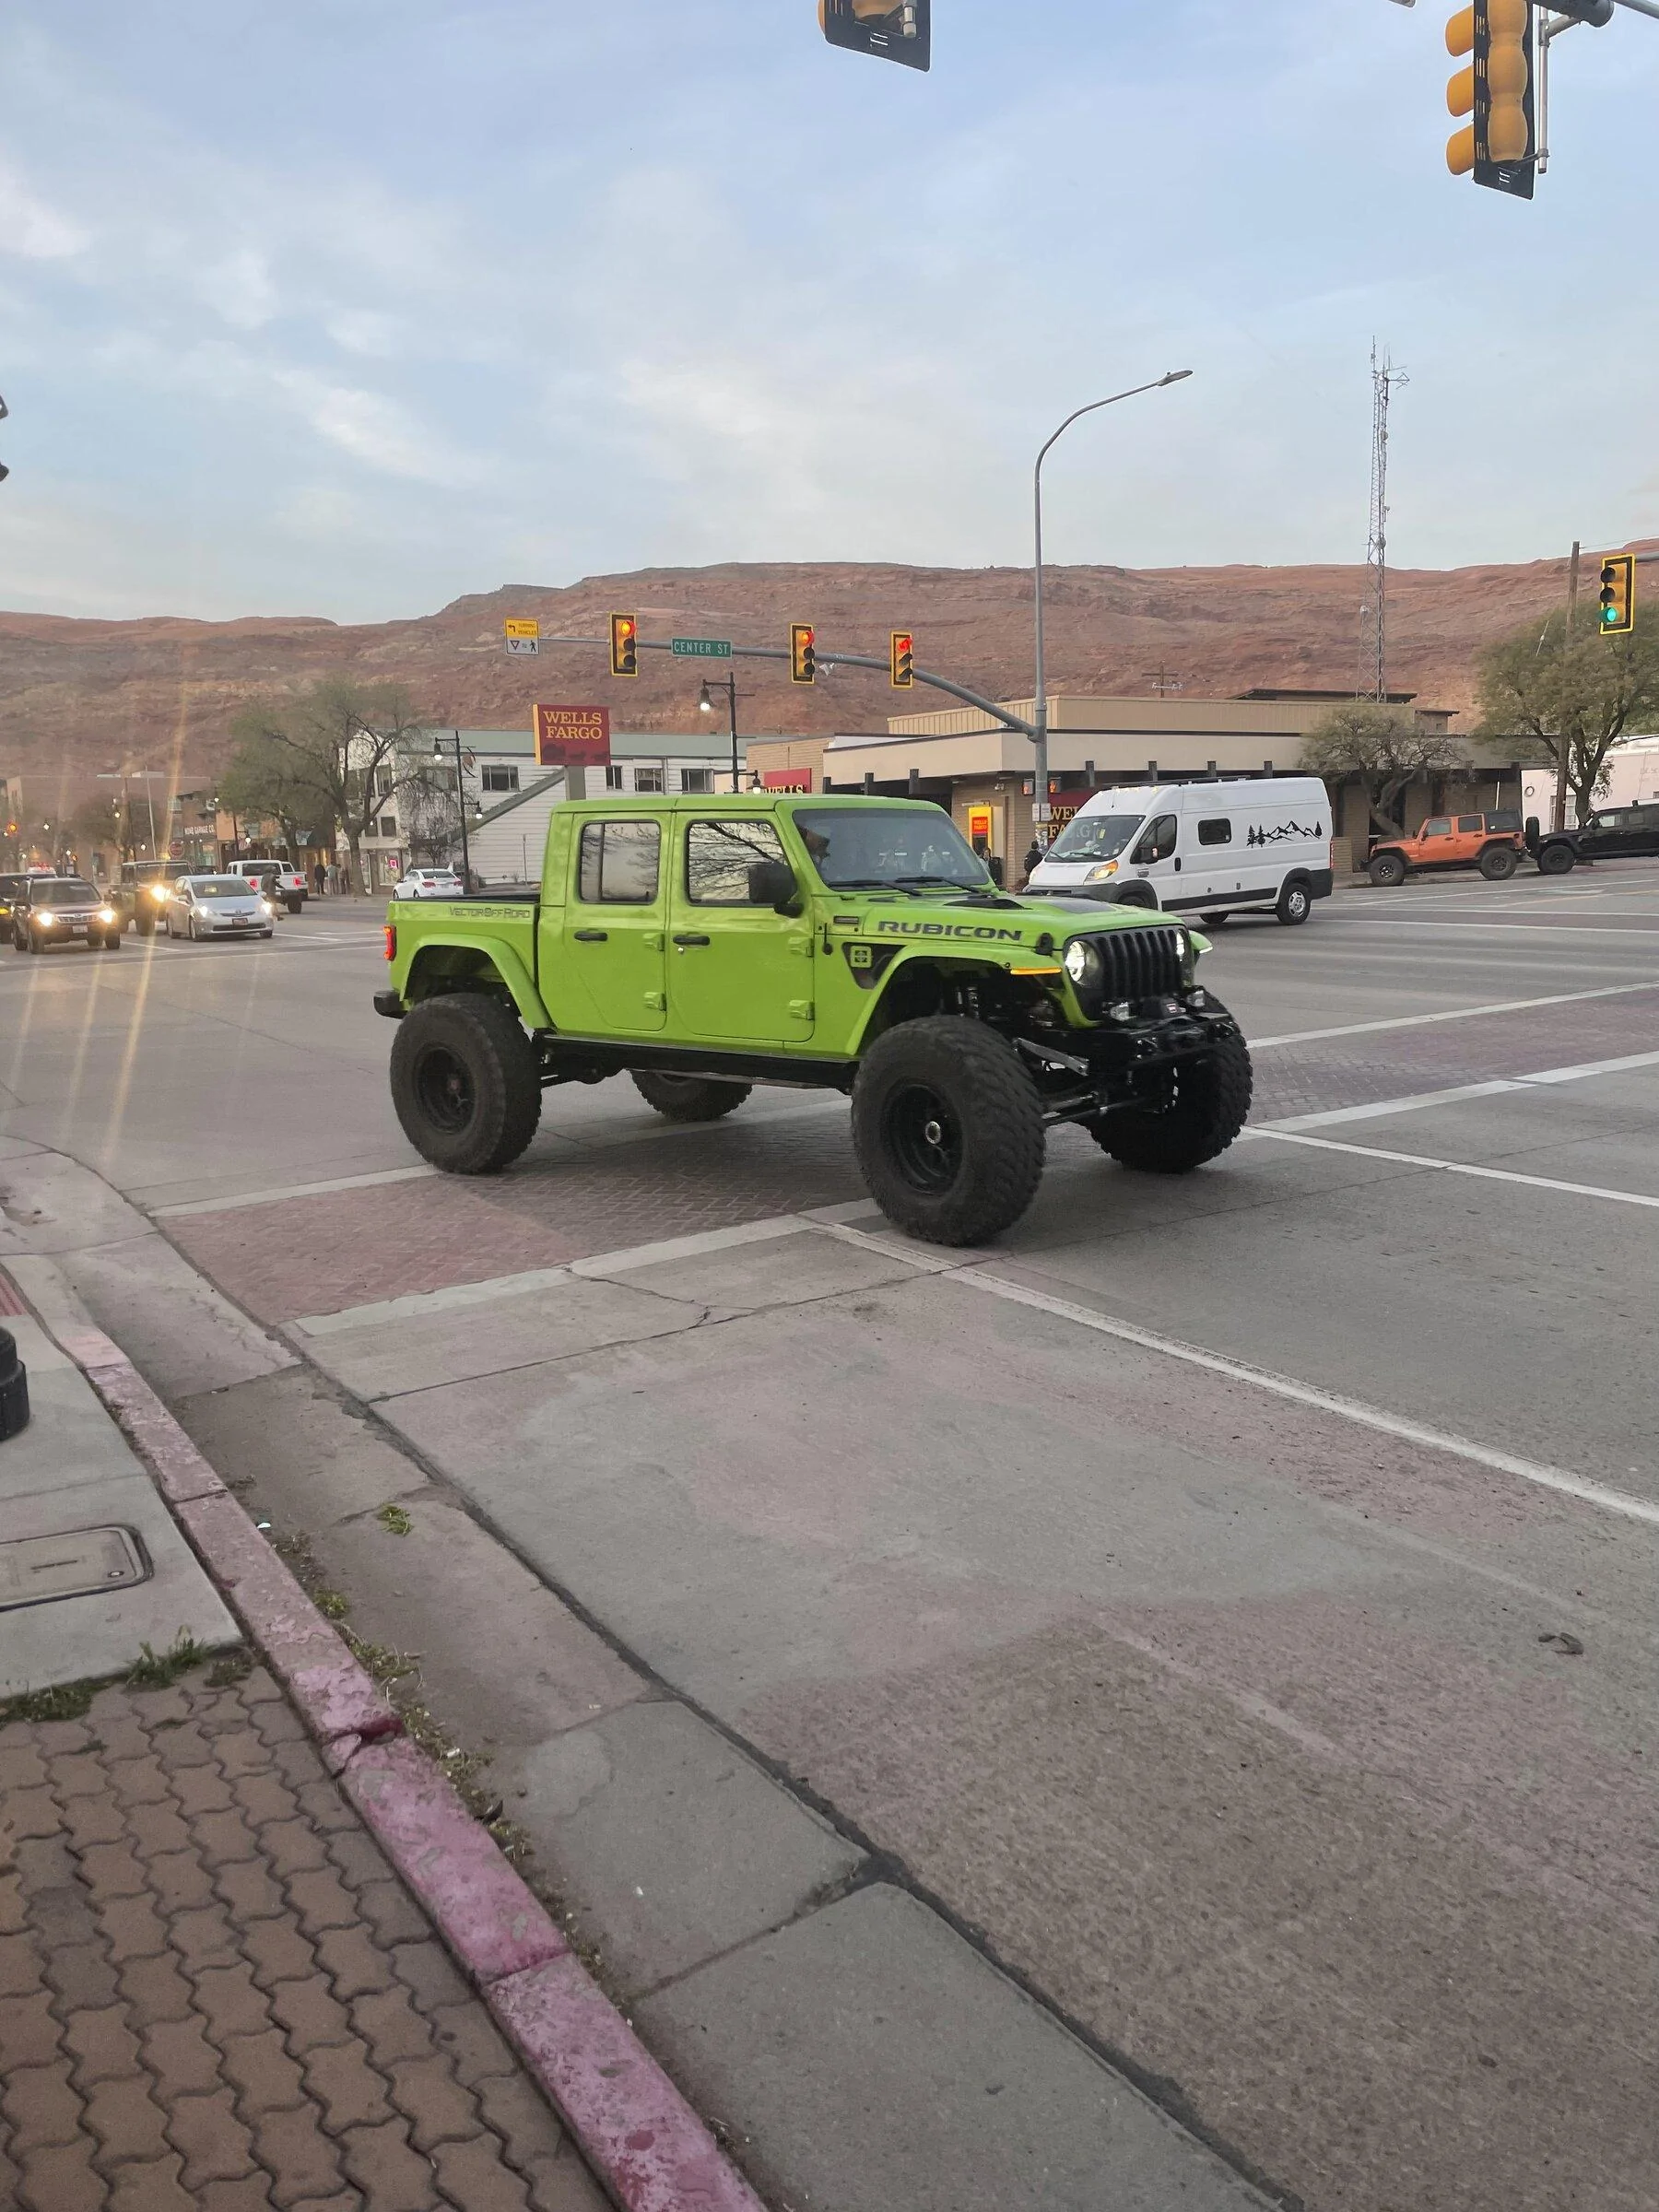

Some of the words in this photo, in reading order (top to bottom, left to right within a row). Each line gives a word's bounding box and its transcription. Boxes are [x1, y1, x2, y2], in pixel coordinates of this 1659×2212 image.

[674, 641, 712, 653] CENTER
[717, 643, 728, 654] ST
[543, 711, 603, 725] WELLS
[546, 725, 603, 740] FARGO
[877, 921, 1022, 941] RUBICON
